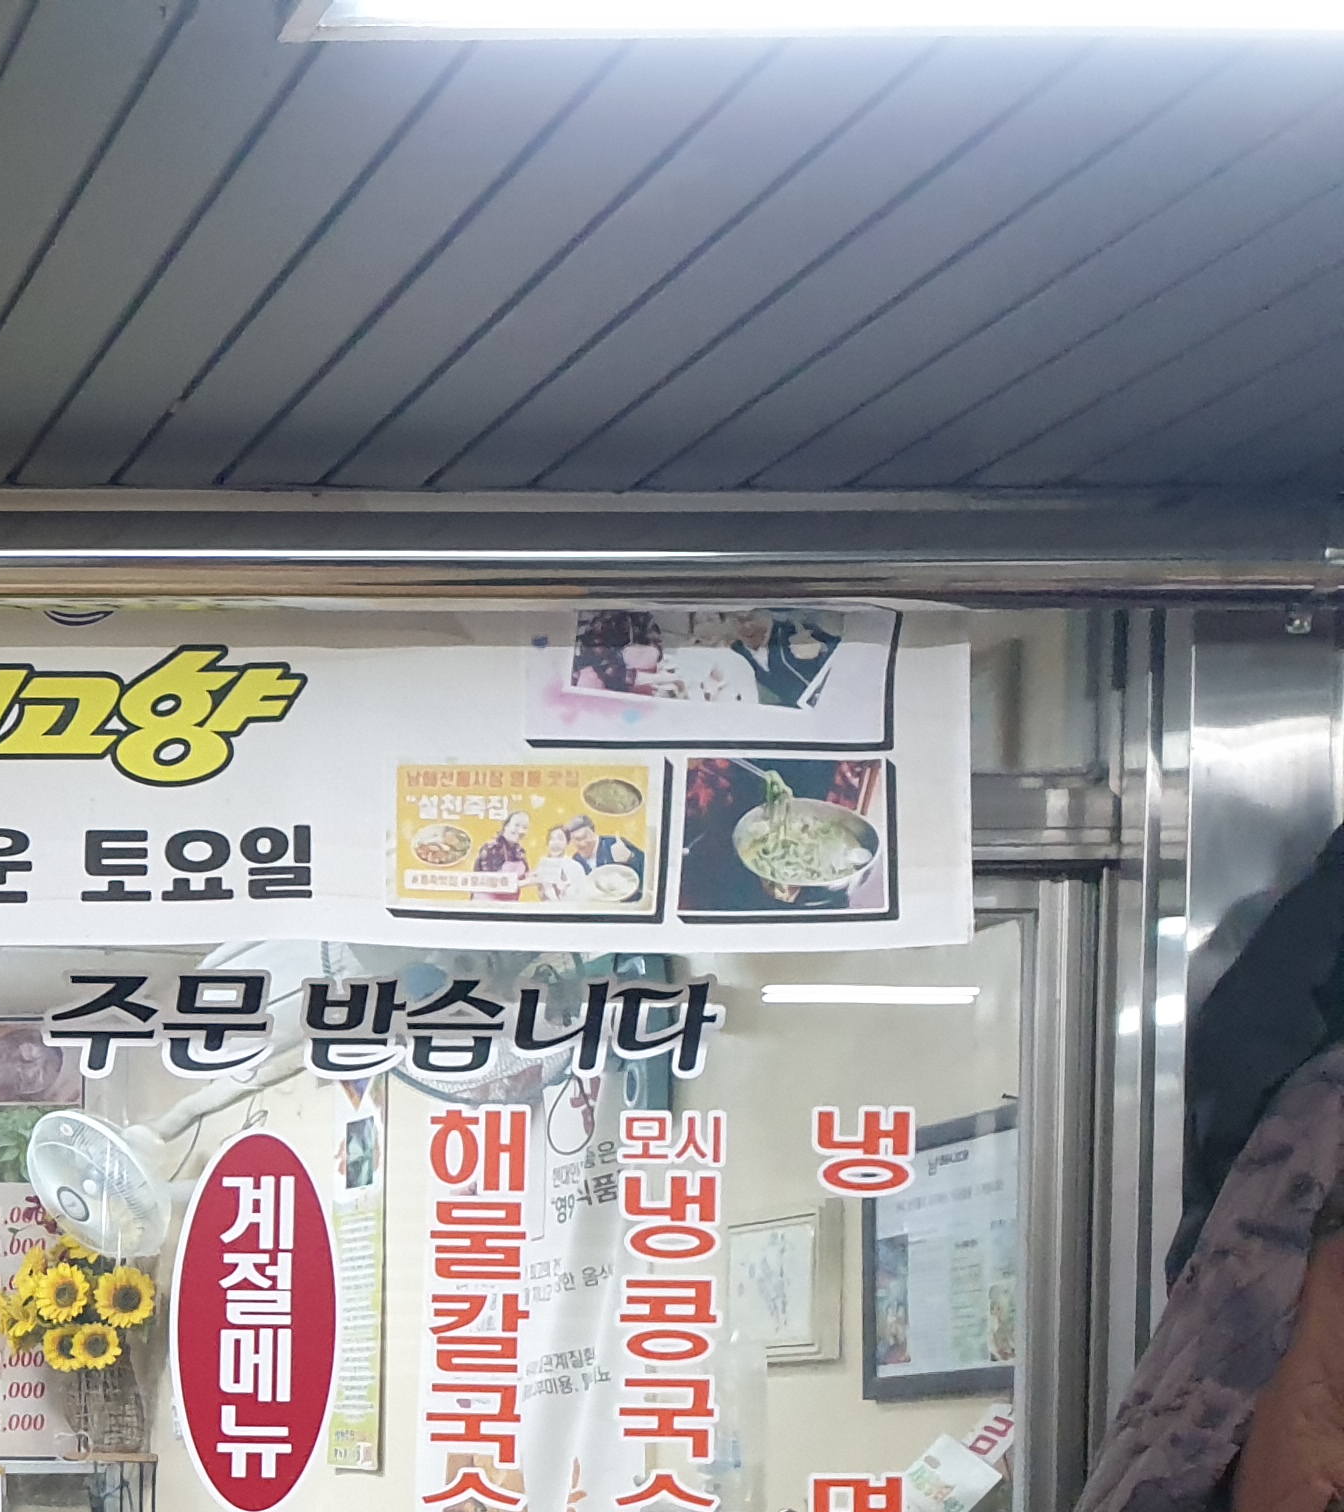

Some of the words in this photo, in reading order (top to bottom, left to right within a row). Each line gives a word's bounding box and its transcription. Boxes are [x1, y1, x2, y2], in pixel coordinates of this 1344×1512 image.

[81, 824, 314, 903] 토요일
[50, 972, 270, 1071] 주문
[304, 978, 716, 1074] 받습니다
[622, 1111, 724, 1165] 모시
[215, 1174, 296, 1485] 계절메뉴
